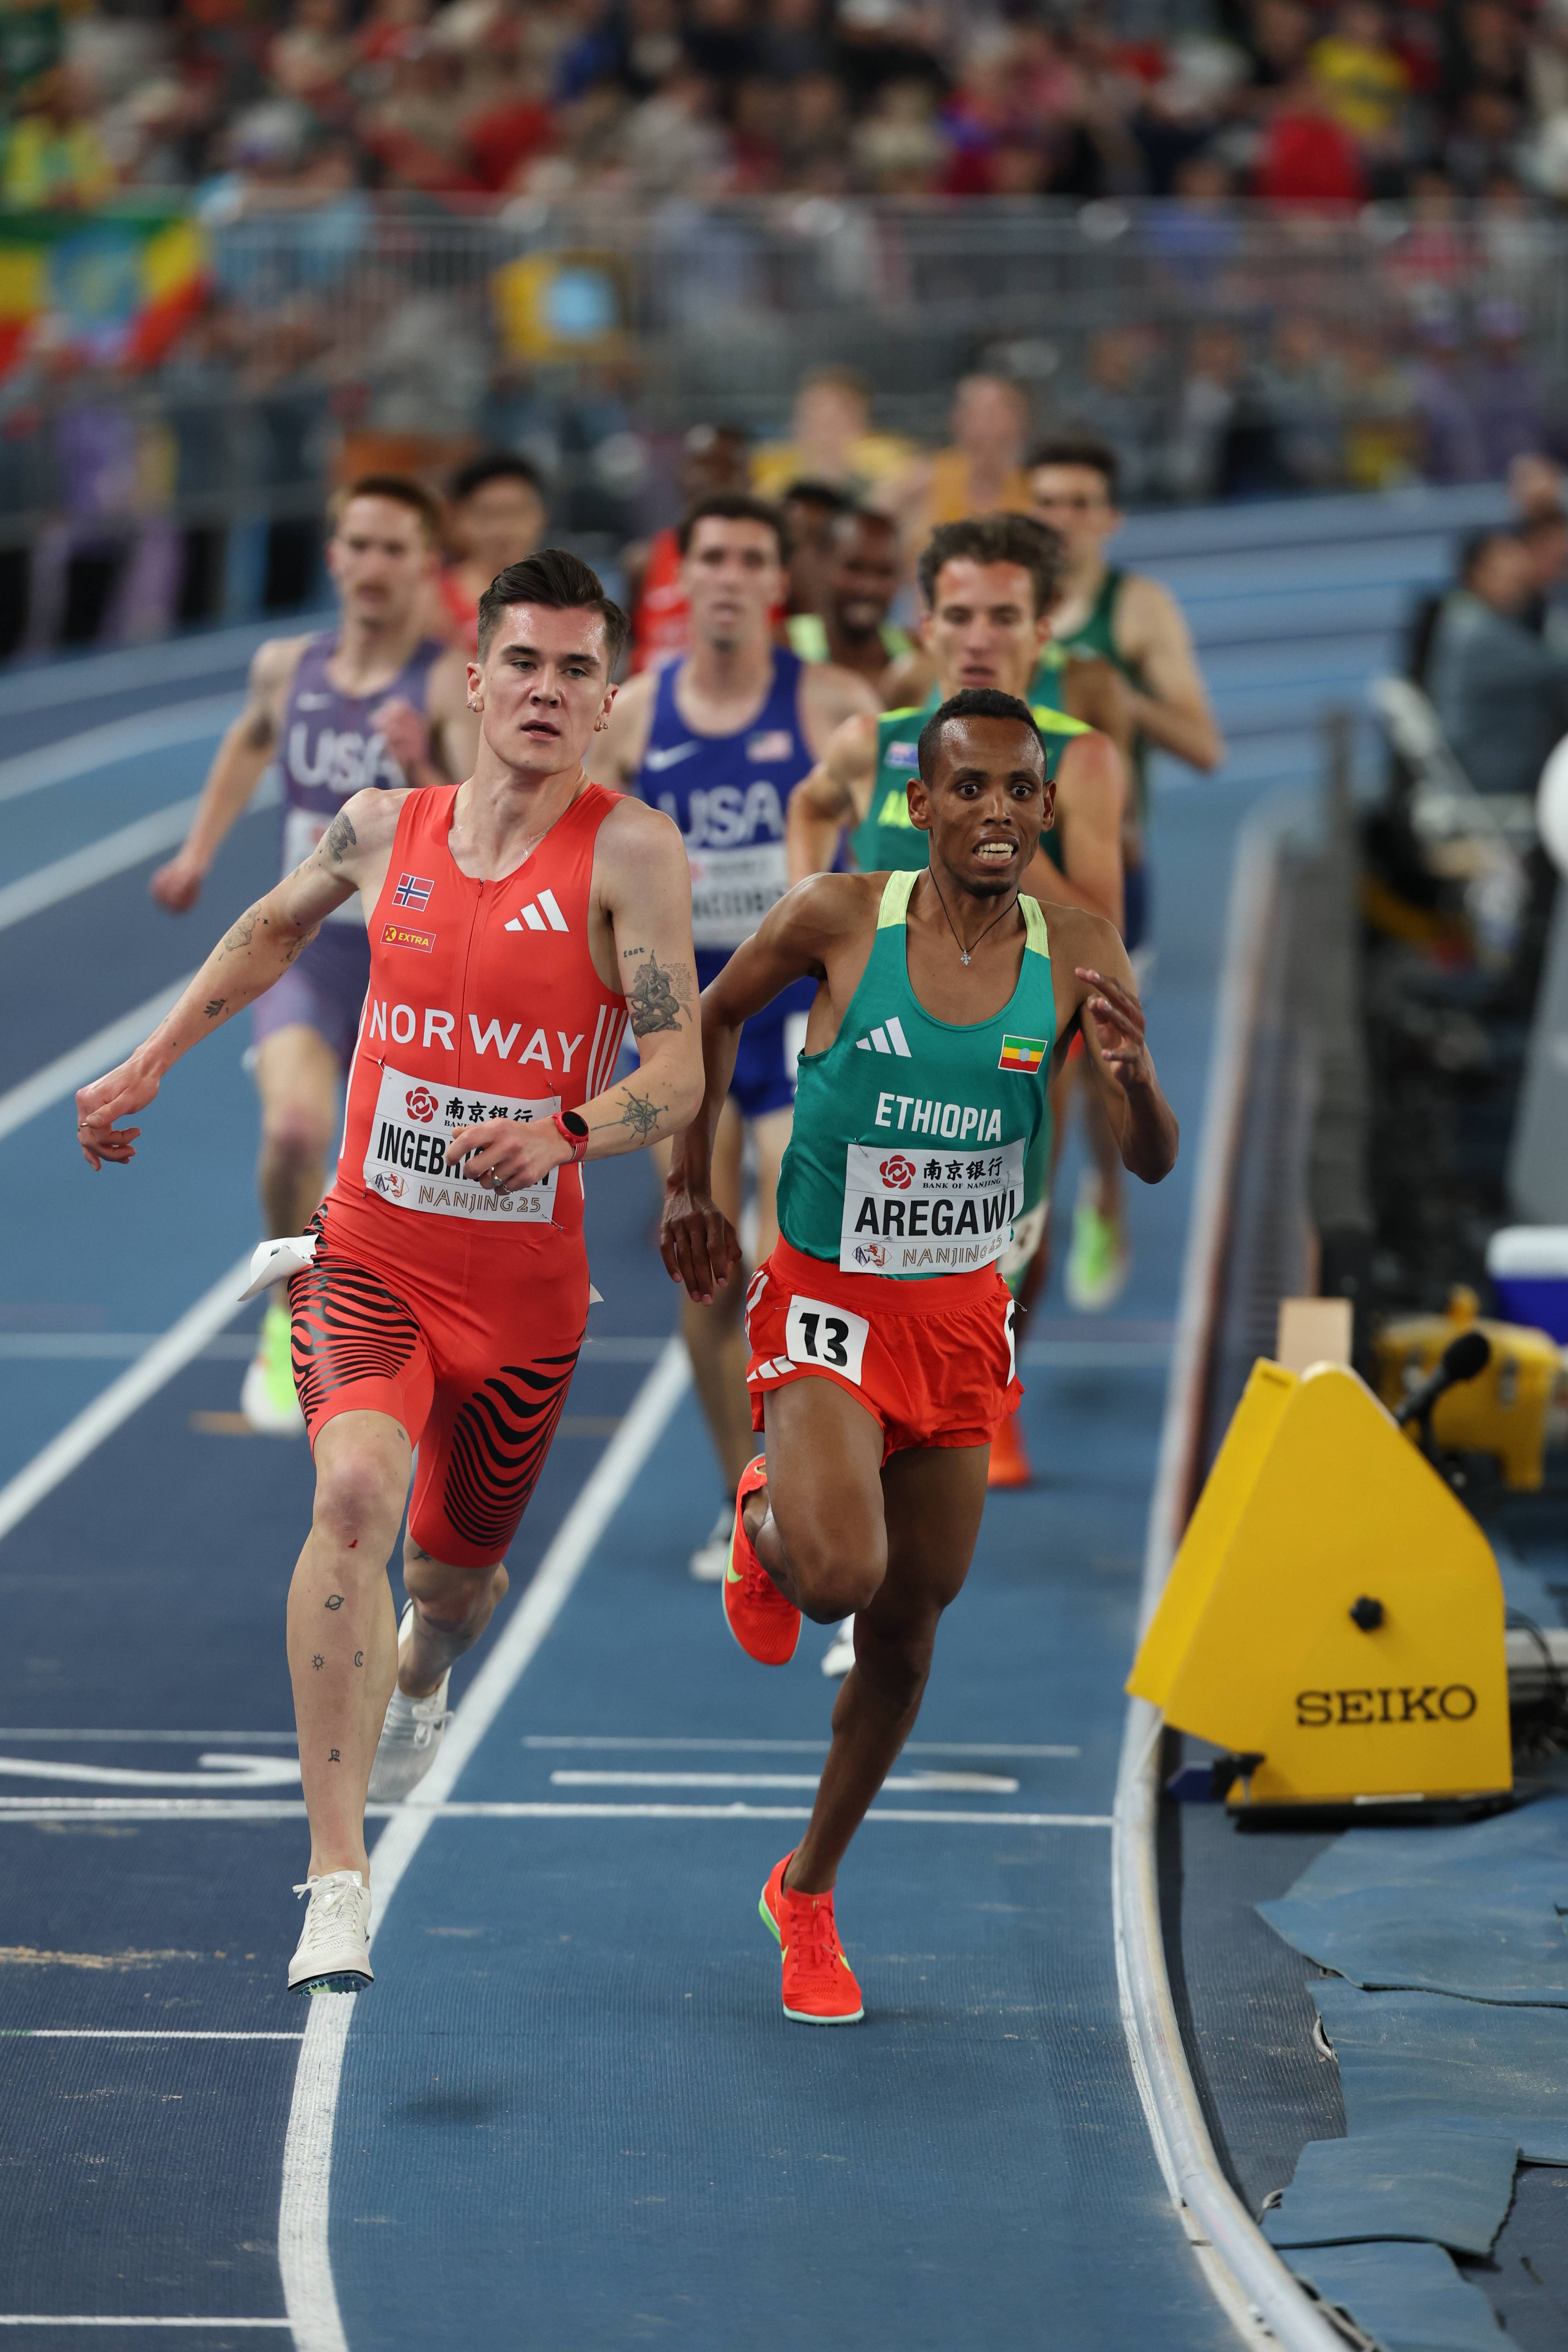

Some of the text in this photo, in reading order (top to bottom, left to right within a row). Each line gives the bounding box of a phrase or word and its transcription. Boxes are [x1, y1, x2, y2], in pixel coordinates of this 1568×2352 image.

[657, 779, 786, 848] USA
[398, 932, 429, 947] EXTRA
[623, 947, 645, 958] fast
[369, 999, 585, 1073] NORWAY
[875, 1092, 1002, 1142] ETHIOPIA
[924, 1156, 1003, 1181] 南京银行
[967, 1178, 1001, 1189] NANJING
[854, 1189, 1015, 1237] AREGAWI
[799, 1313, 849, 1367] 13
[1296, 1684, 1477, 1726] SEIKO
